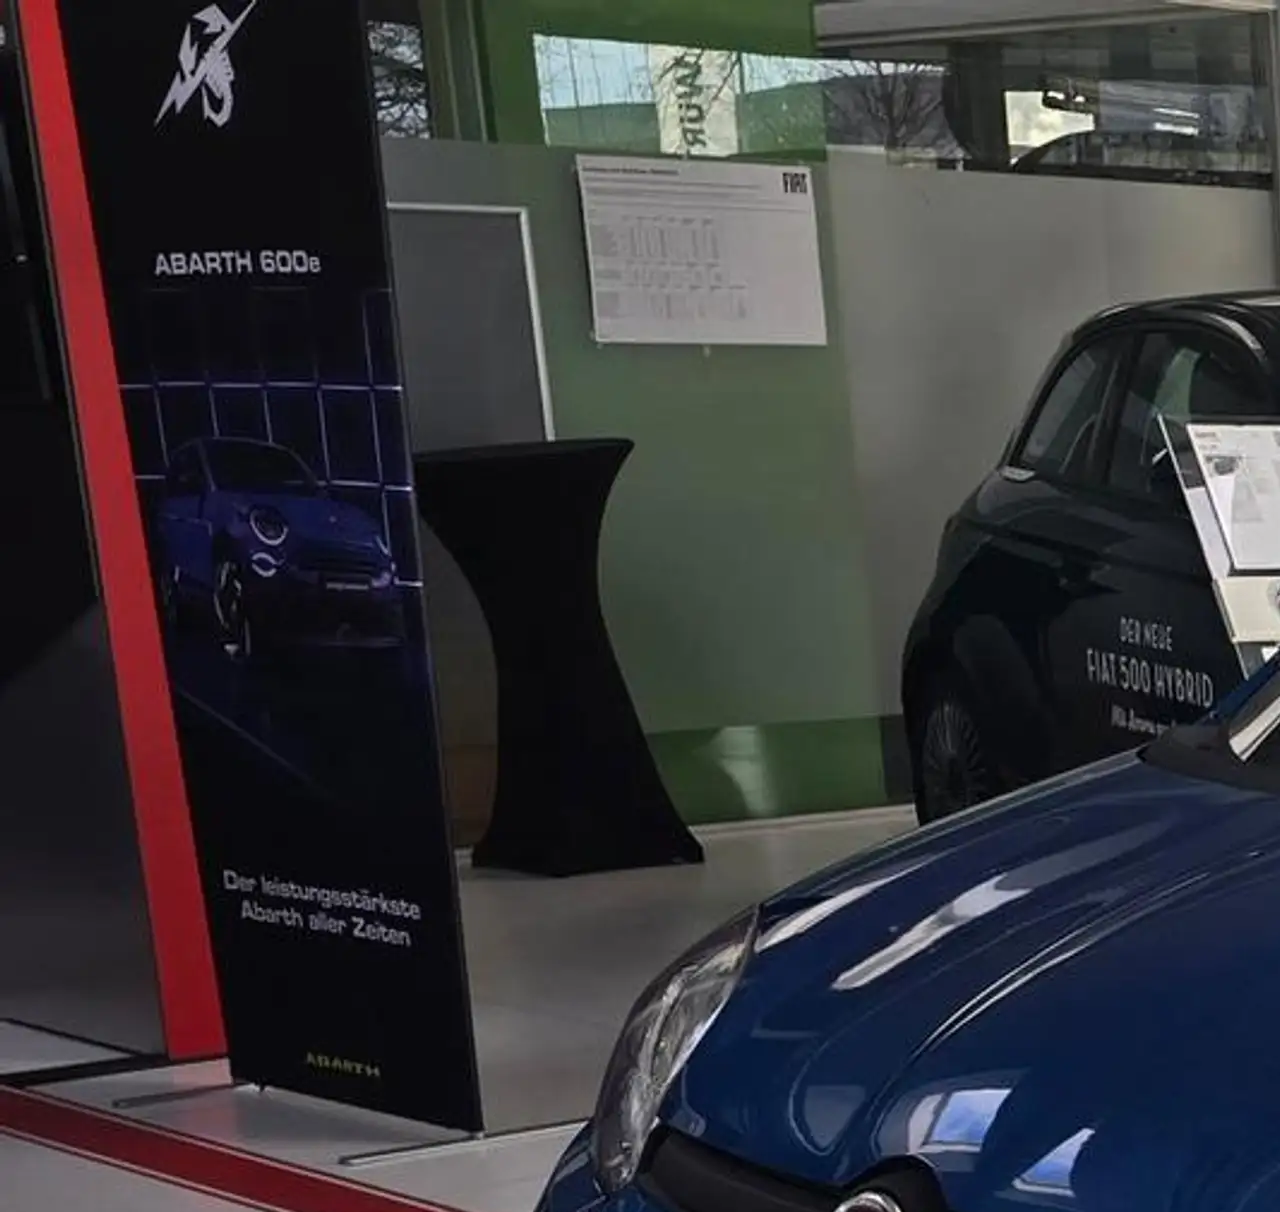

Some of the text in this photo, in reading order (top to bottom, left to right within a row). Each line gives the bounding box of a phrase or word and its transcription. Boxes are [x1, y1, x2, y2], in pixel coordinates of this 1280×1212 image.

[154, 249, 321, 276] ABARTH 600e
[1120, 616, 1173, 653] DER NEUE
[1086, 647, 1214, 708] FIAT 500 HYBRID
[222, 869, 421, 921] Der leistungsstärkste
[240, 899, 412, 948] Abarth aller Zeiten
